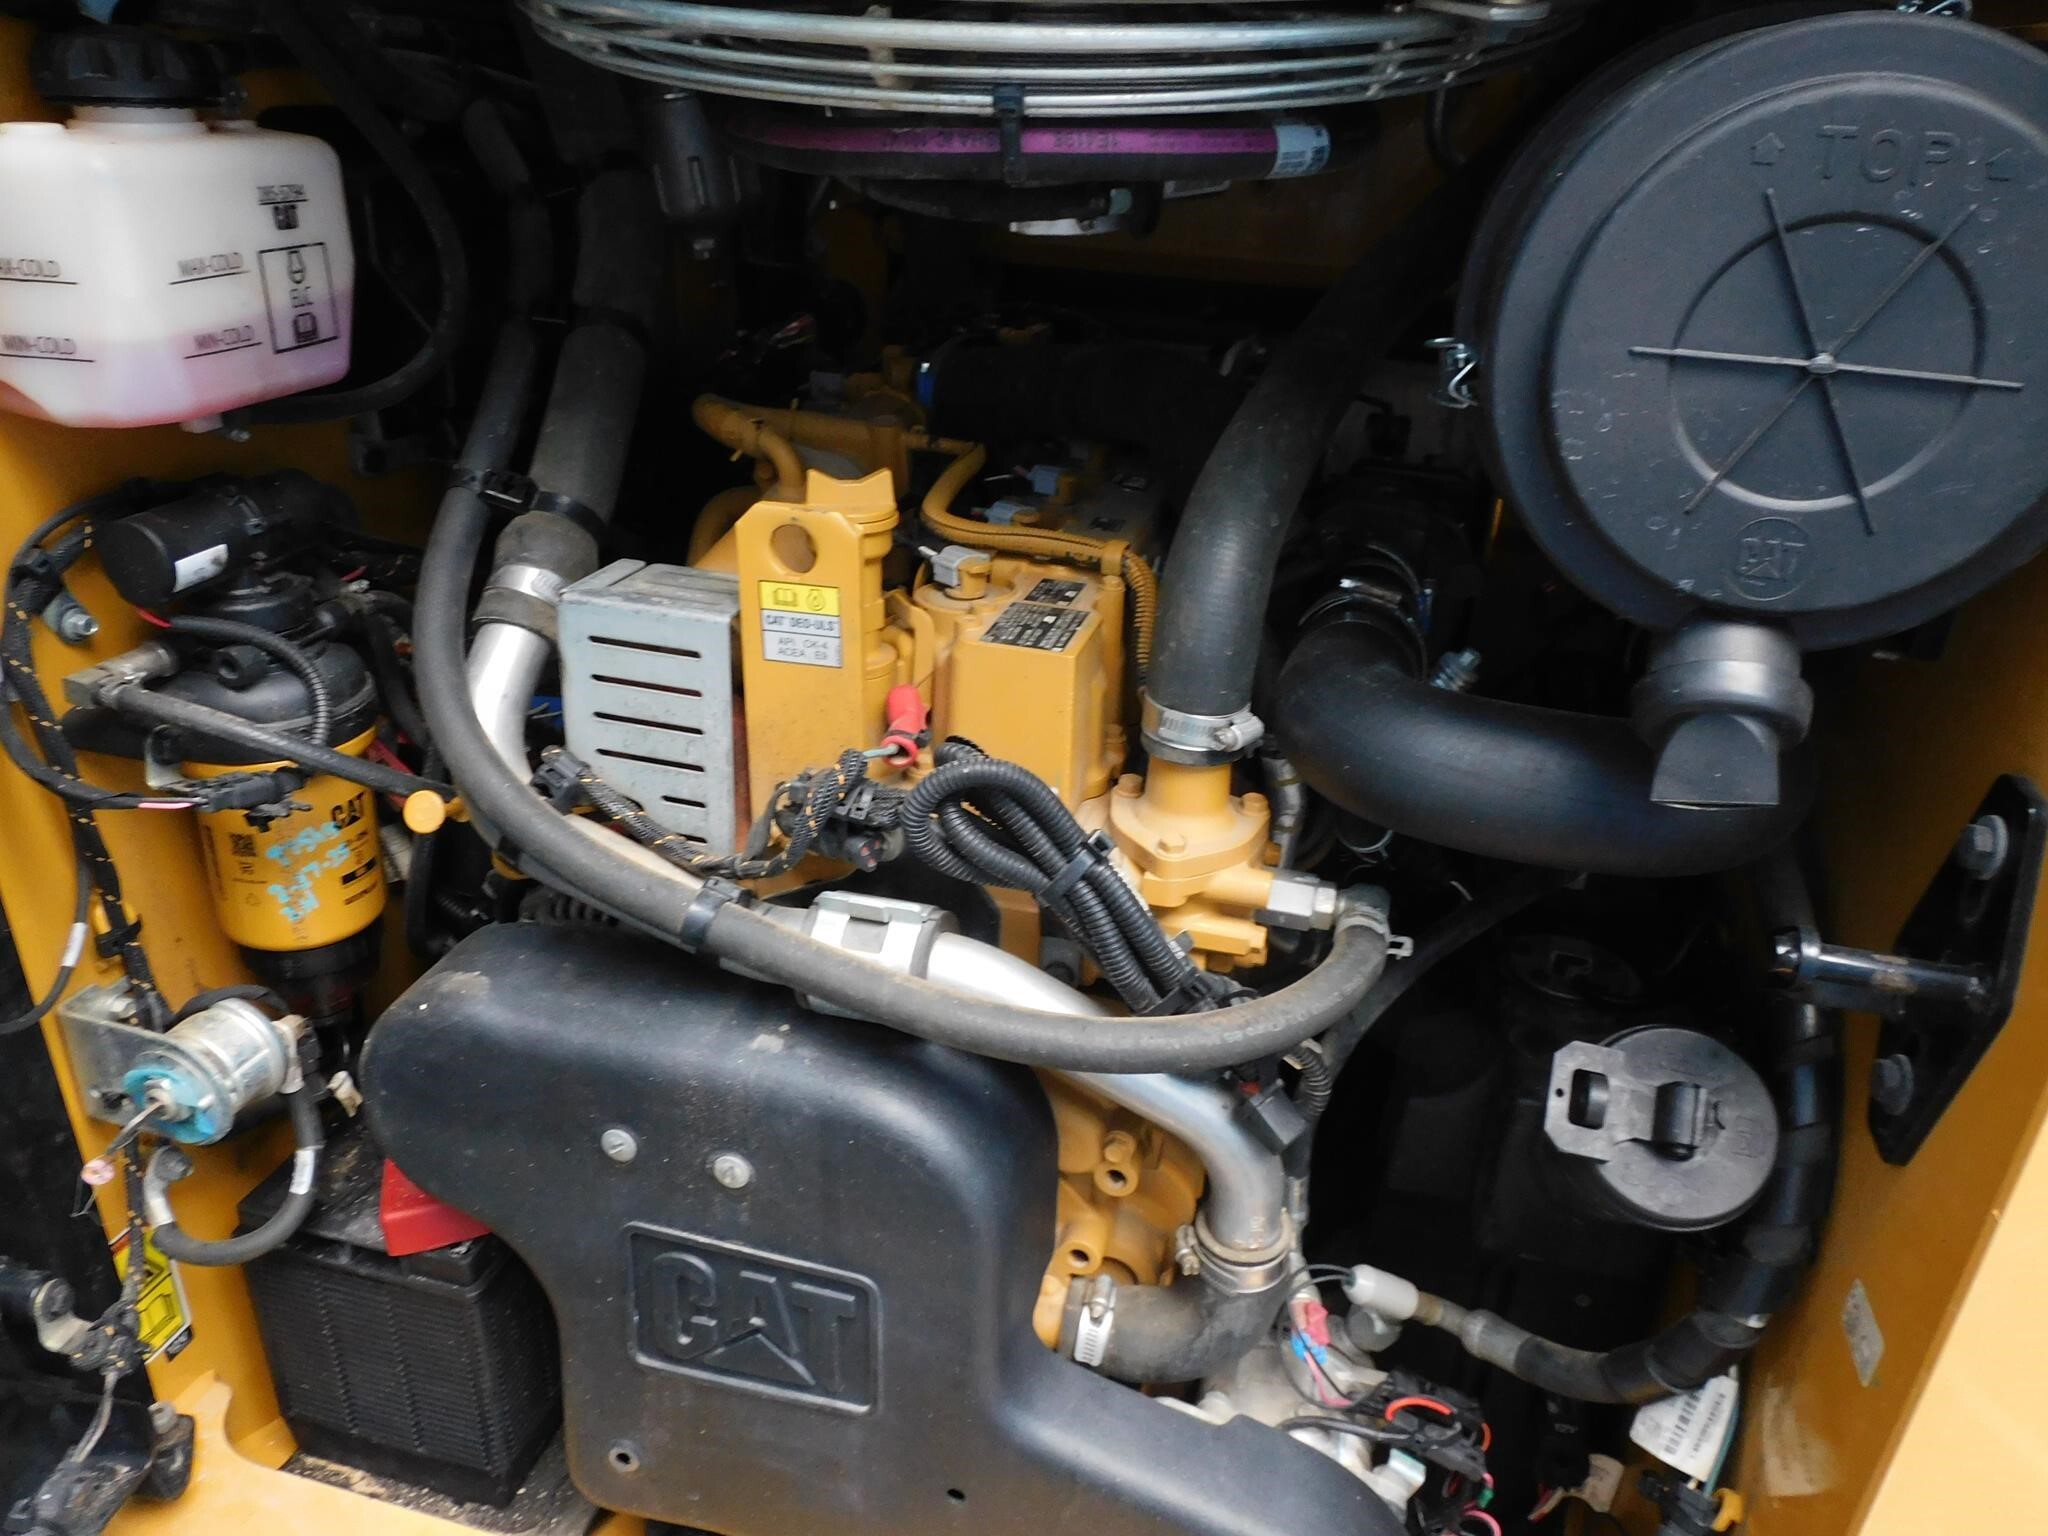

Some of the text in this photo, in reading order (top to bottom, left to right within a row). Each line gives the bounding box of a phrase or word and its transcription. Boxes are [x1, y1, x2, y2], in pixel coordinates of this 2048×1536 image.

[1814, 123, 1961, 188] TOP
[331, 791, 365, 830] CAT
[652, 1251, 857, 1391] CAT
